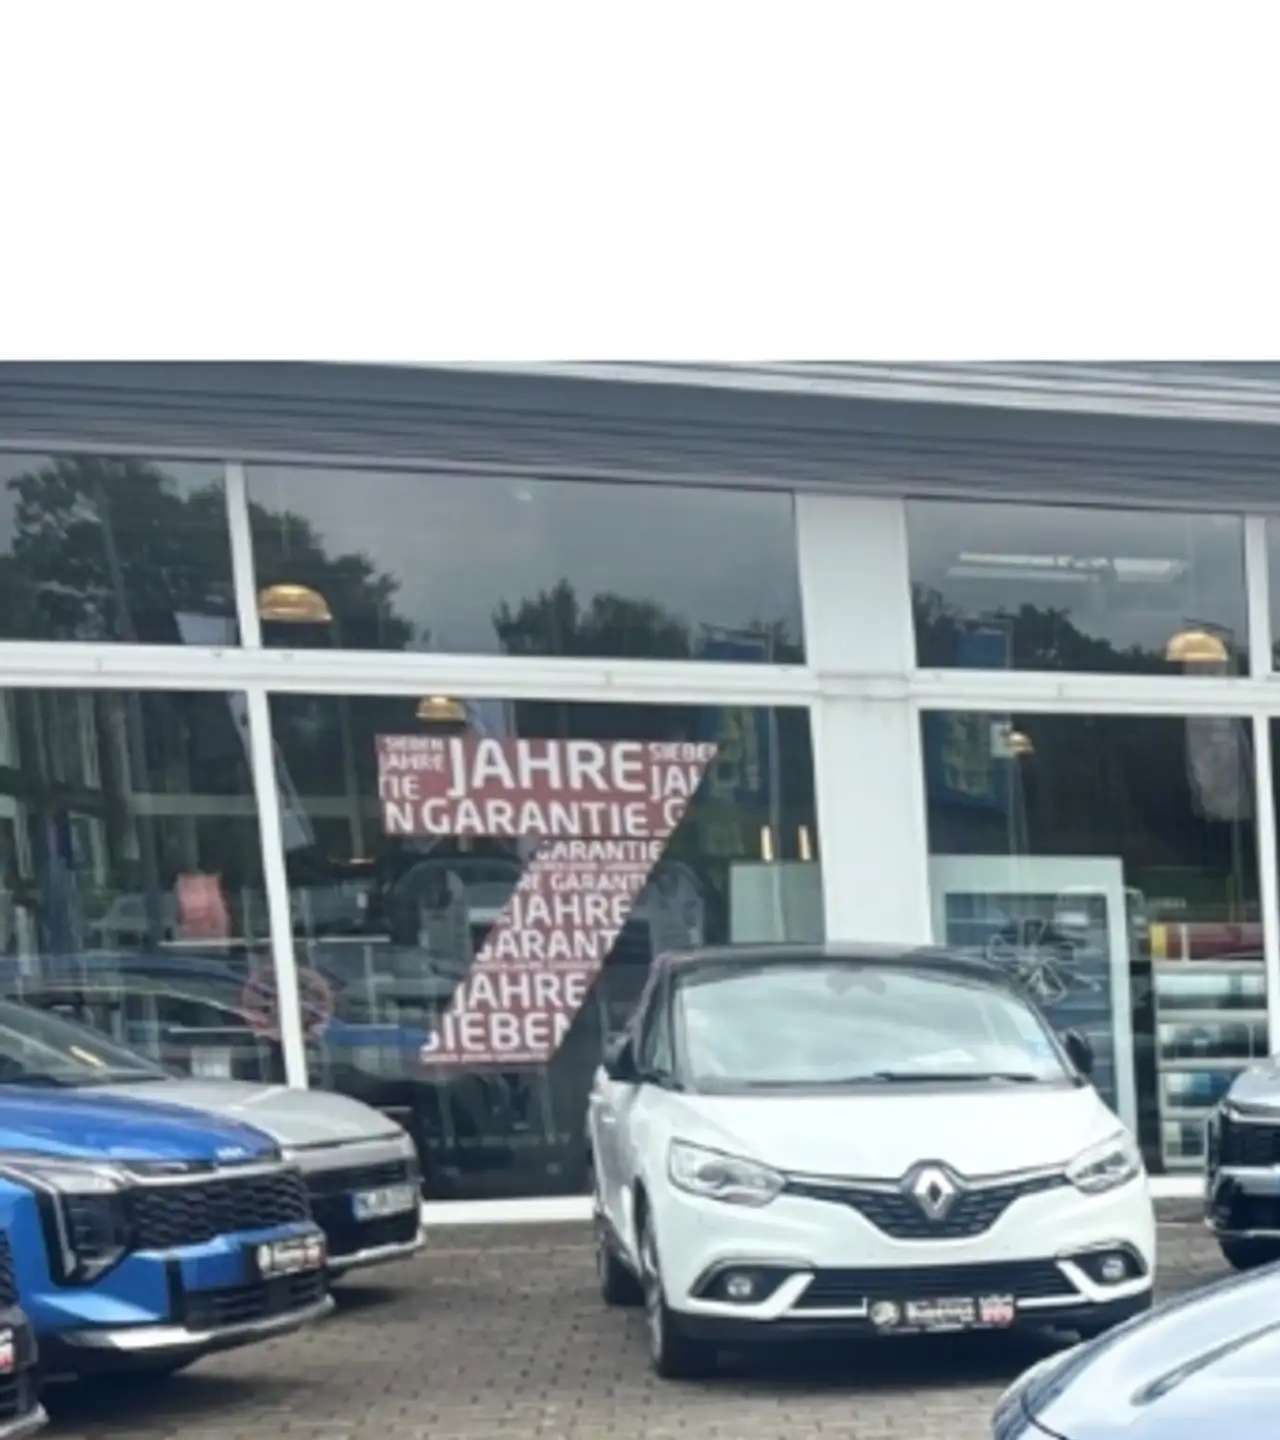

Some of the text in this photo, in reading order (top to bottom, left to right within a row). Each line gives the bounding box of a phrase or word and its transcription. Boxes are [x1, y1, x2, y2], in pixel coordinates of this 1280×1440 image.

[446, 737, 648, 798] JAHRE
[421, 798, 649, 836] GARANTIE
[510, 893, 632, 932] JAHRE
[453, 972, 587, 1016] JAHRE
